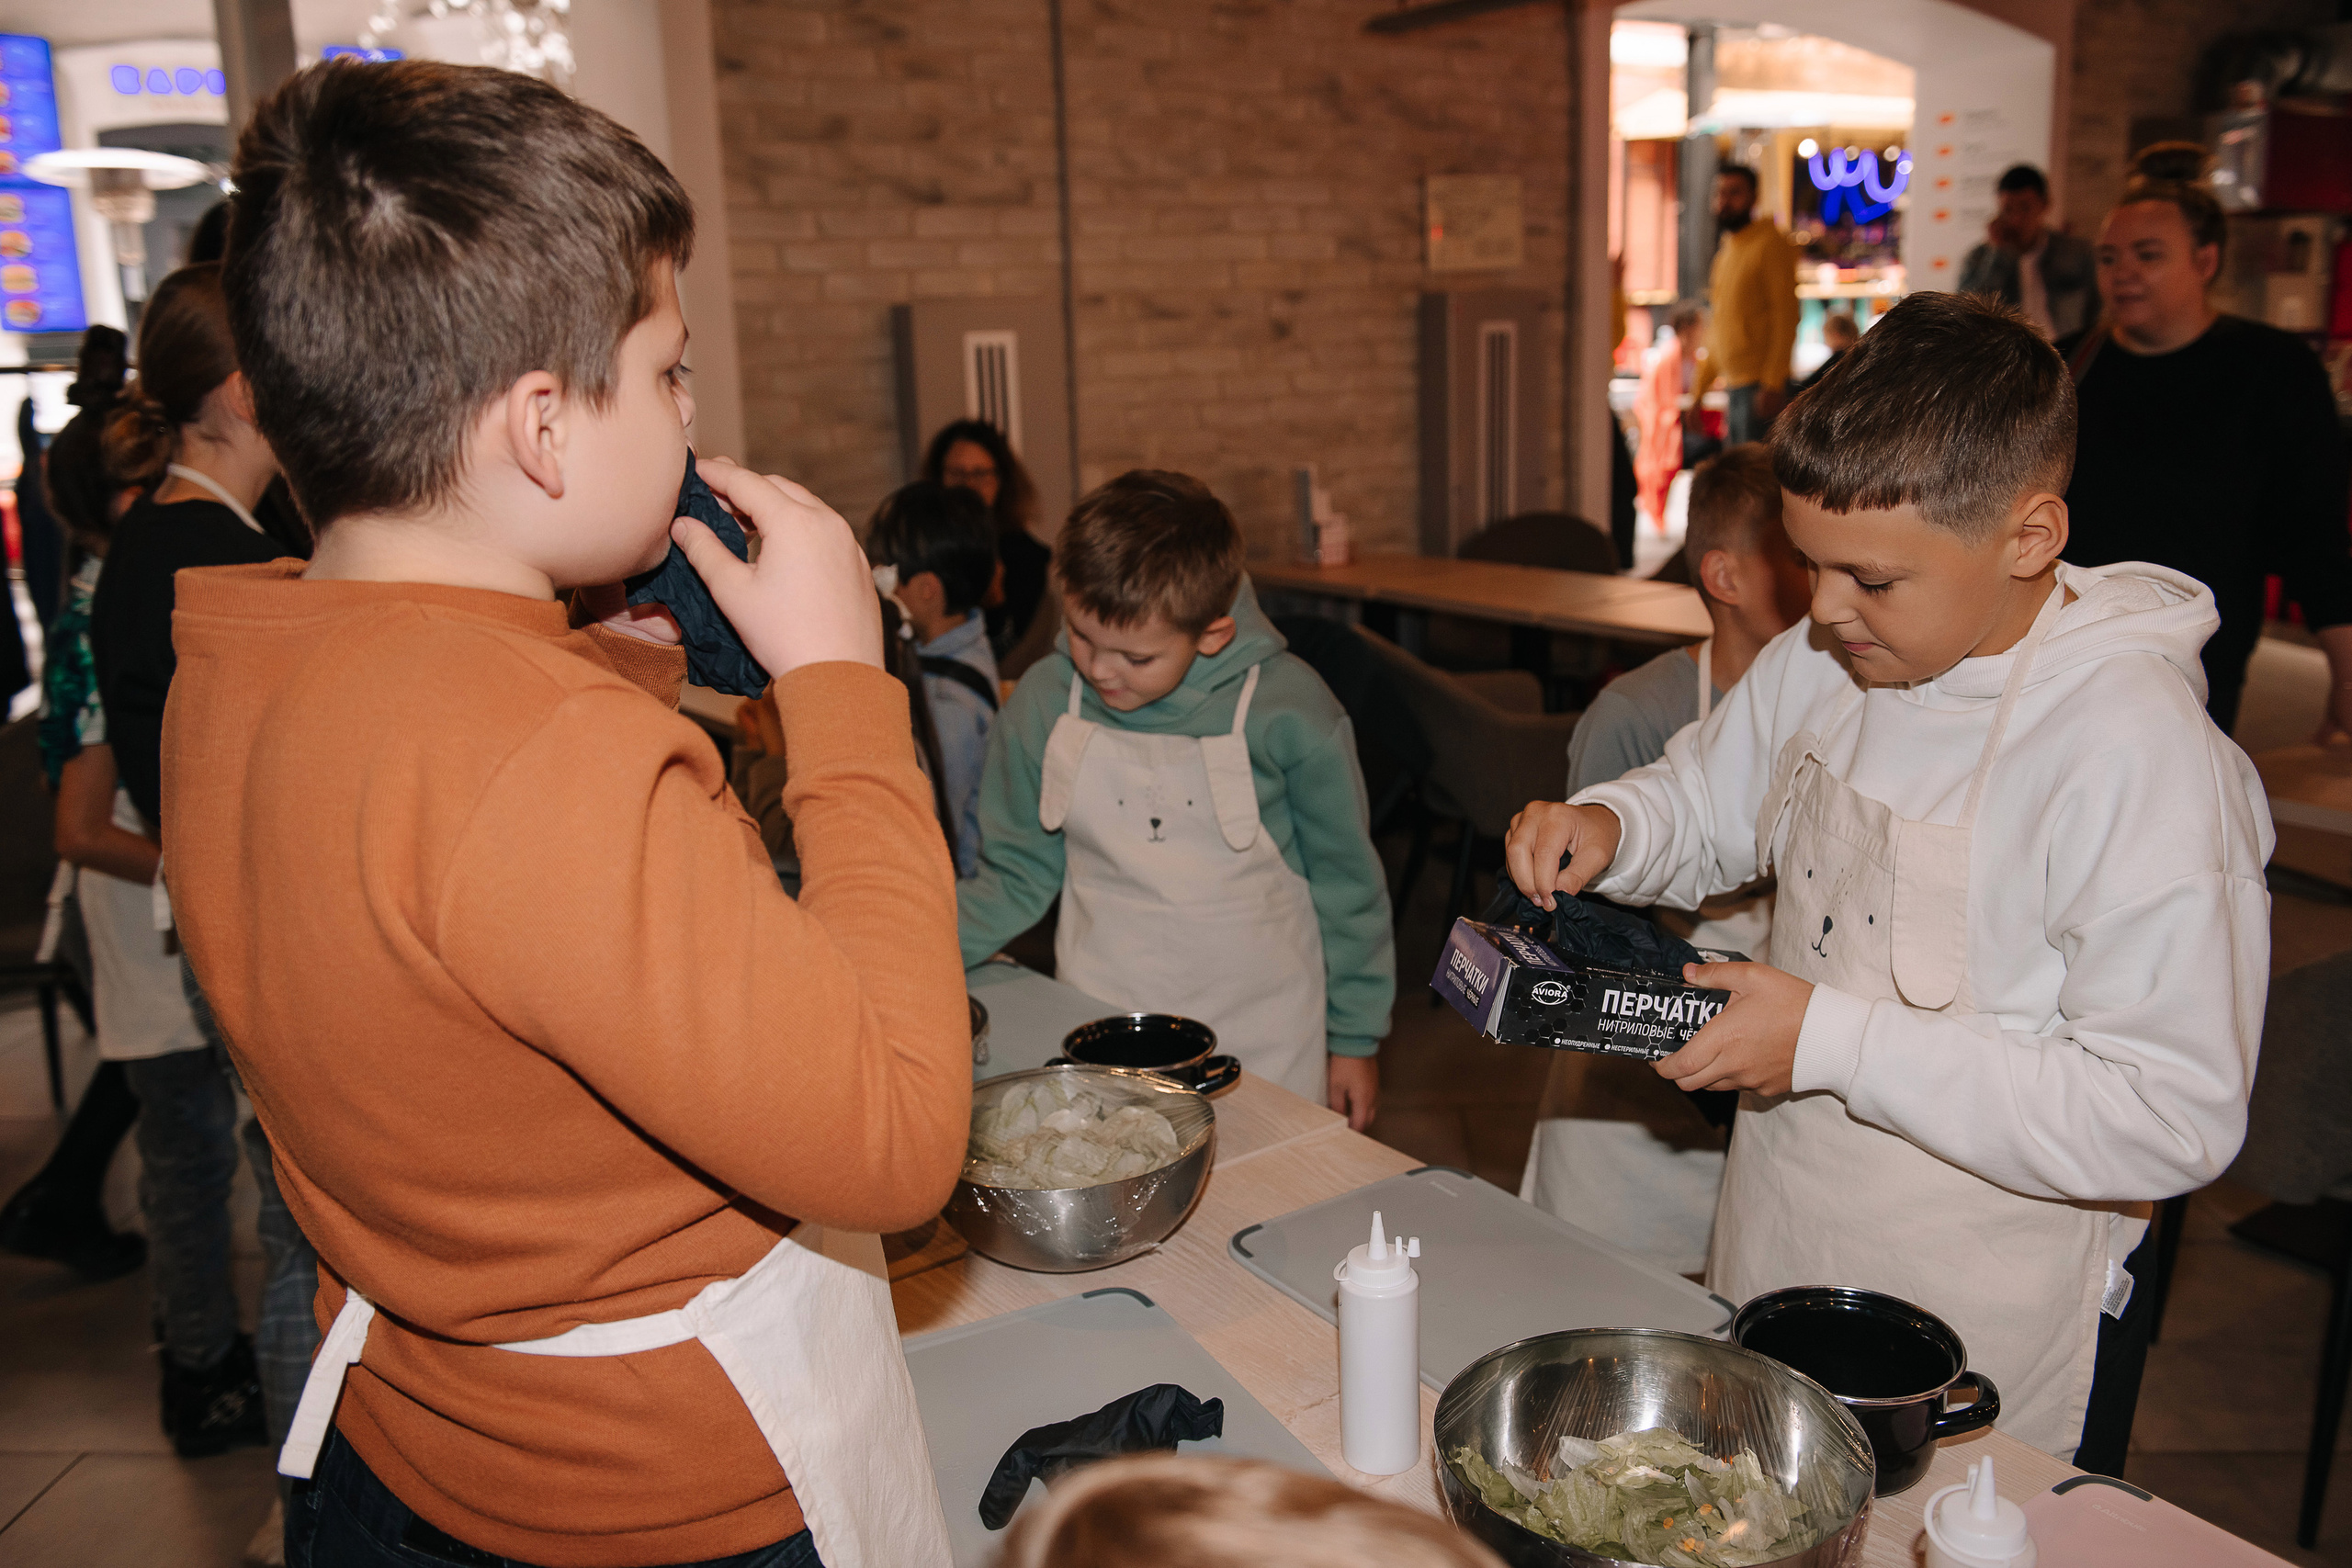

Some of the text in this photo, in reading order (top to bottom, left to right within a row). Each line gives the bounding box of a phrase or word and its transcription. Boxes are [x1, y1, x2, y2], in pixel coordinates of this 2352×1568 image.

[1450, 948, 1489, 995] ПЕРЧАТКИ
[1532, 987, 1568, 998] AVIORA
[1597, 1018, 1675, 1040] НИТРИЛОВЫЕ
[1611, 1044, 1650, 1055] НЕСТЕРИЛЬНЫЕ
